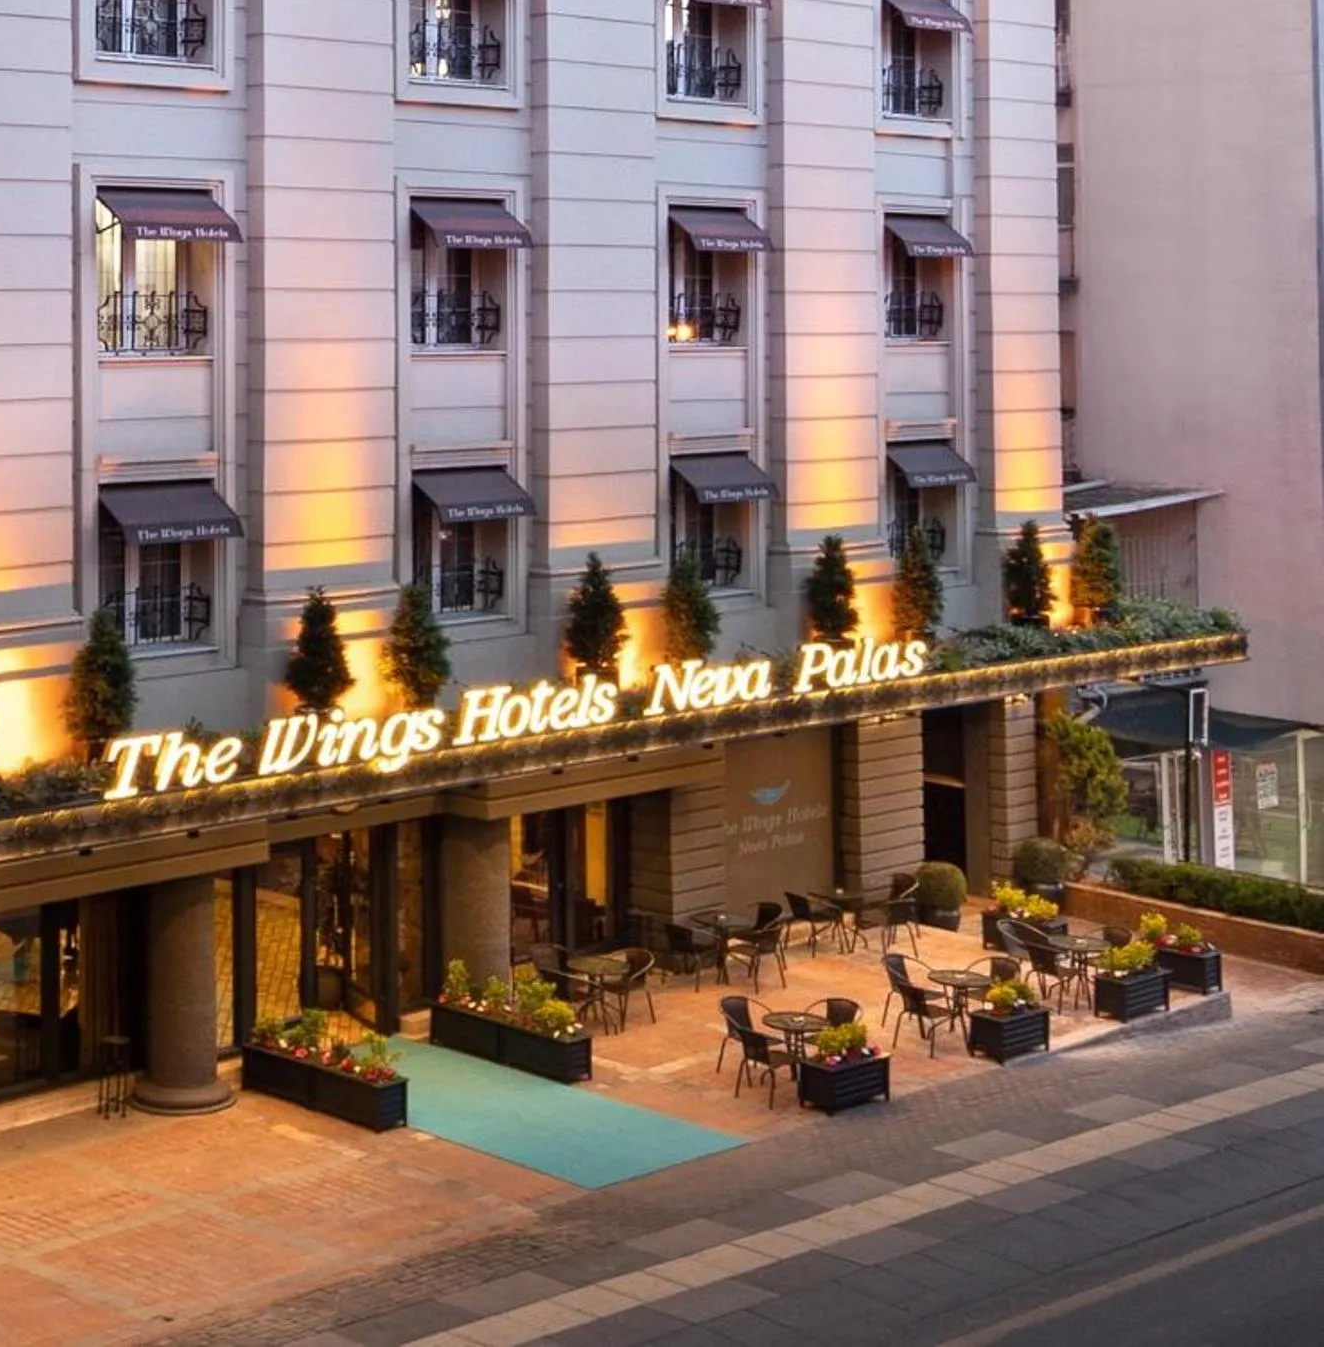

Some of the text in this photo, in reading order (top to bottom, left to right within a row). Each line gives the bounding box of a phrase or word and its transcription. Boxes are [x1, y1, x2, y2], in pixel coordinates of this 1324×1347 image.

[103, 636, 927, 800] The Wings Hotels Neva Palas
[723, 820, 738, 835] he
